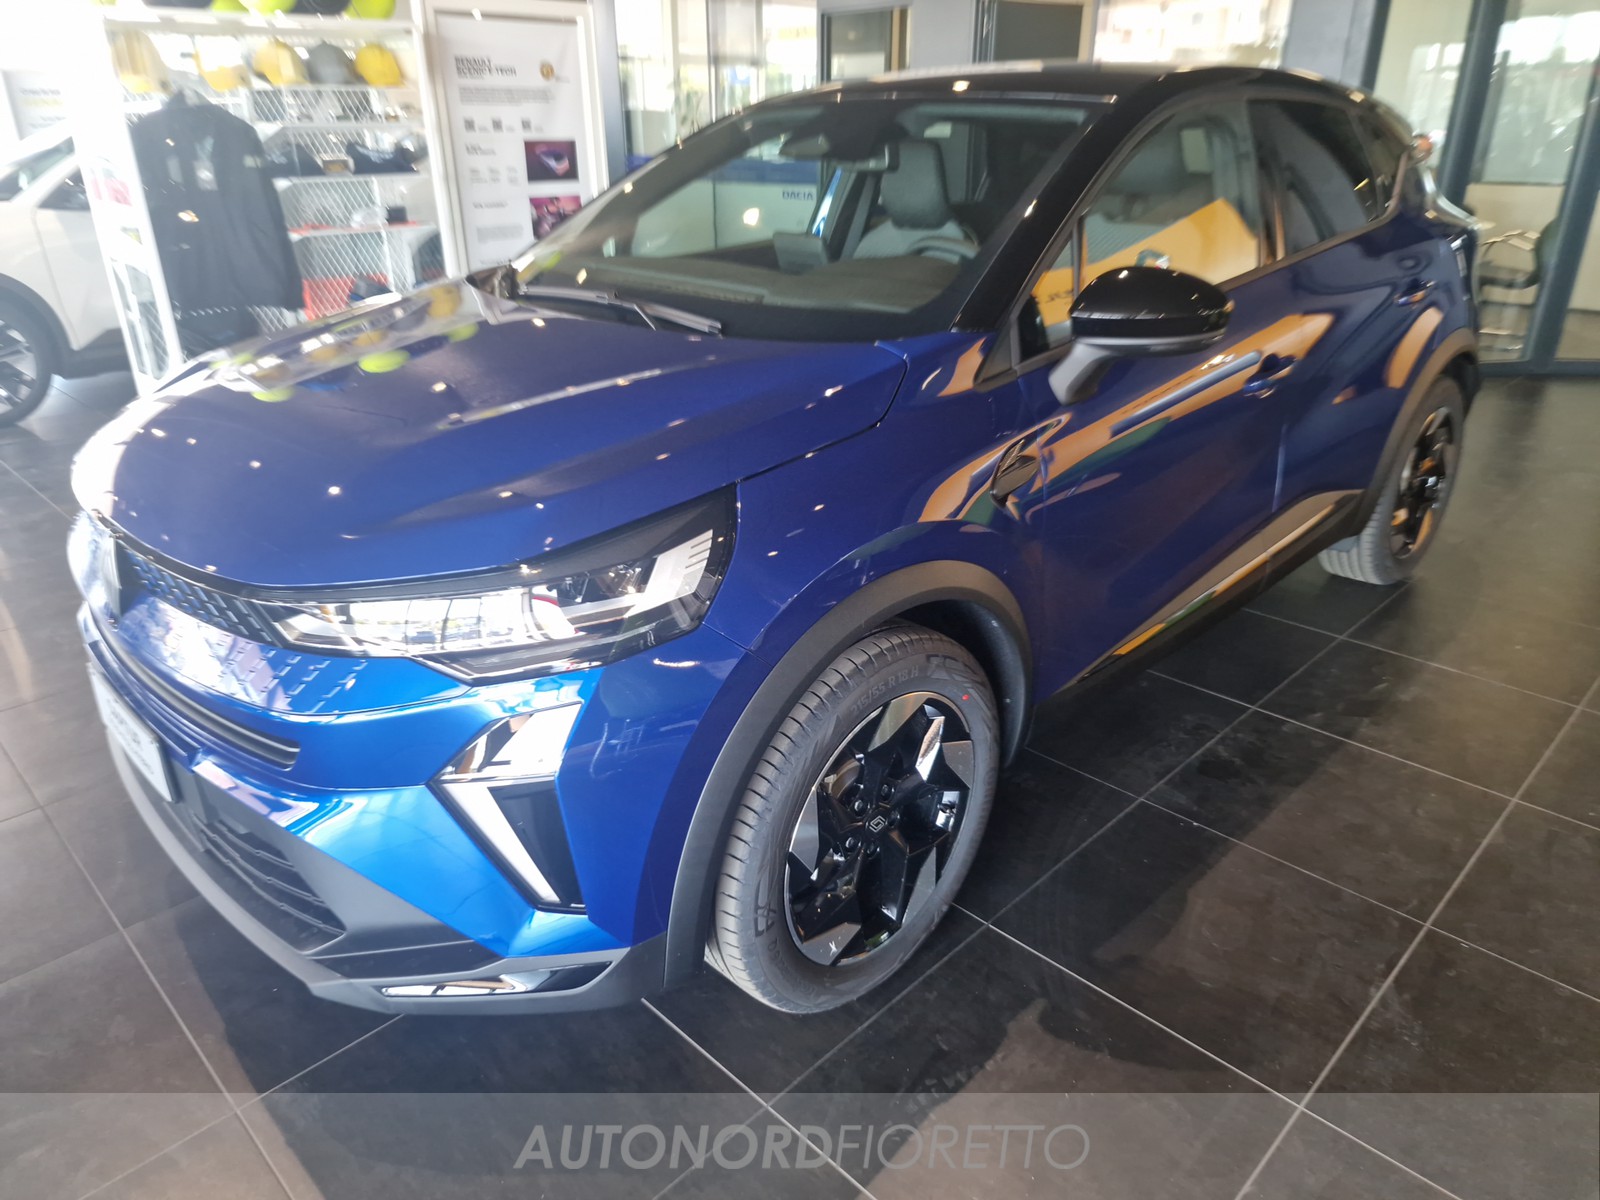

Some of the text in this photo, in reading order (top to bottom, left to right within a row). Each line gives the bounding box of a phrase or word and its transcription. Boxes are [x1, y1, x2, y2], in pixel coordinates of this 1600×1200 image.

[850, 666, 920, 714] 215/55 R 18 H
